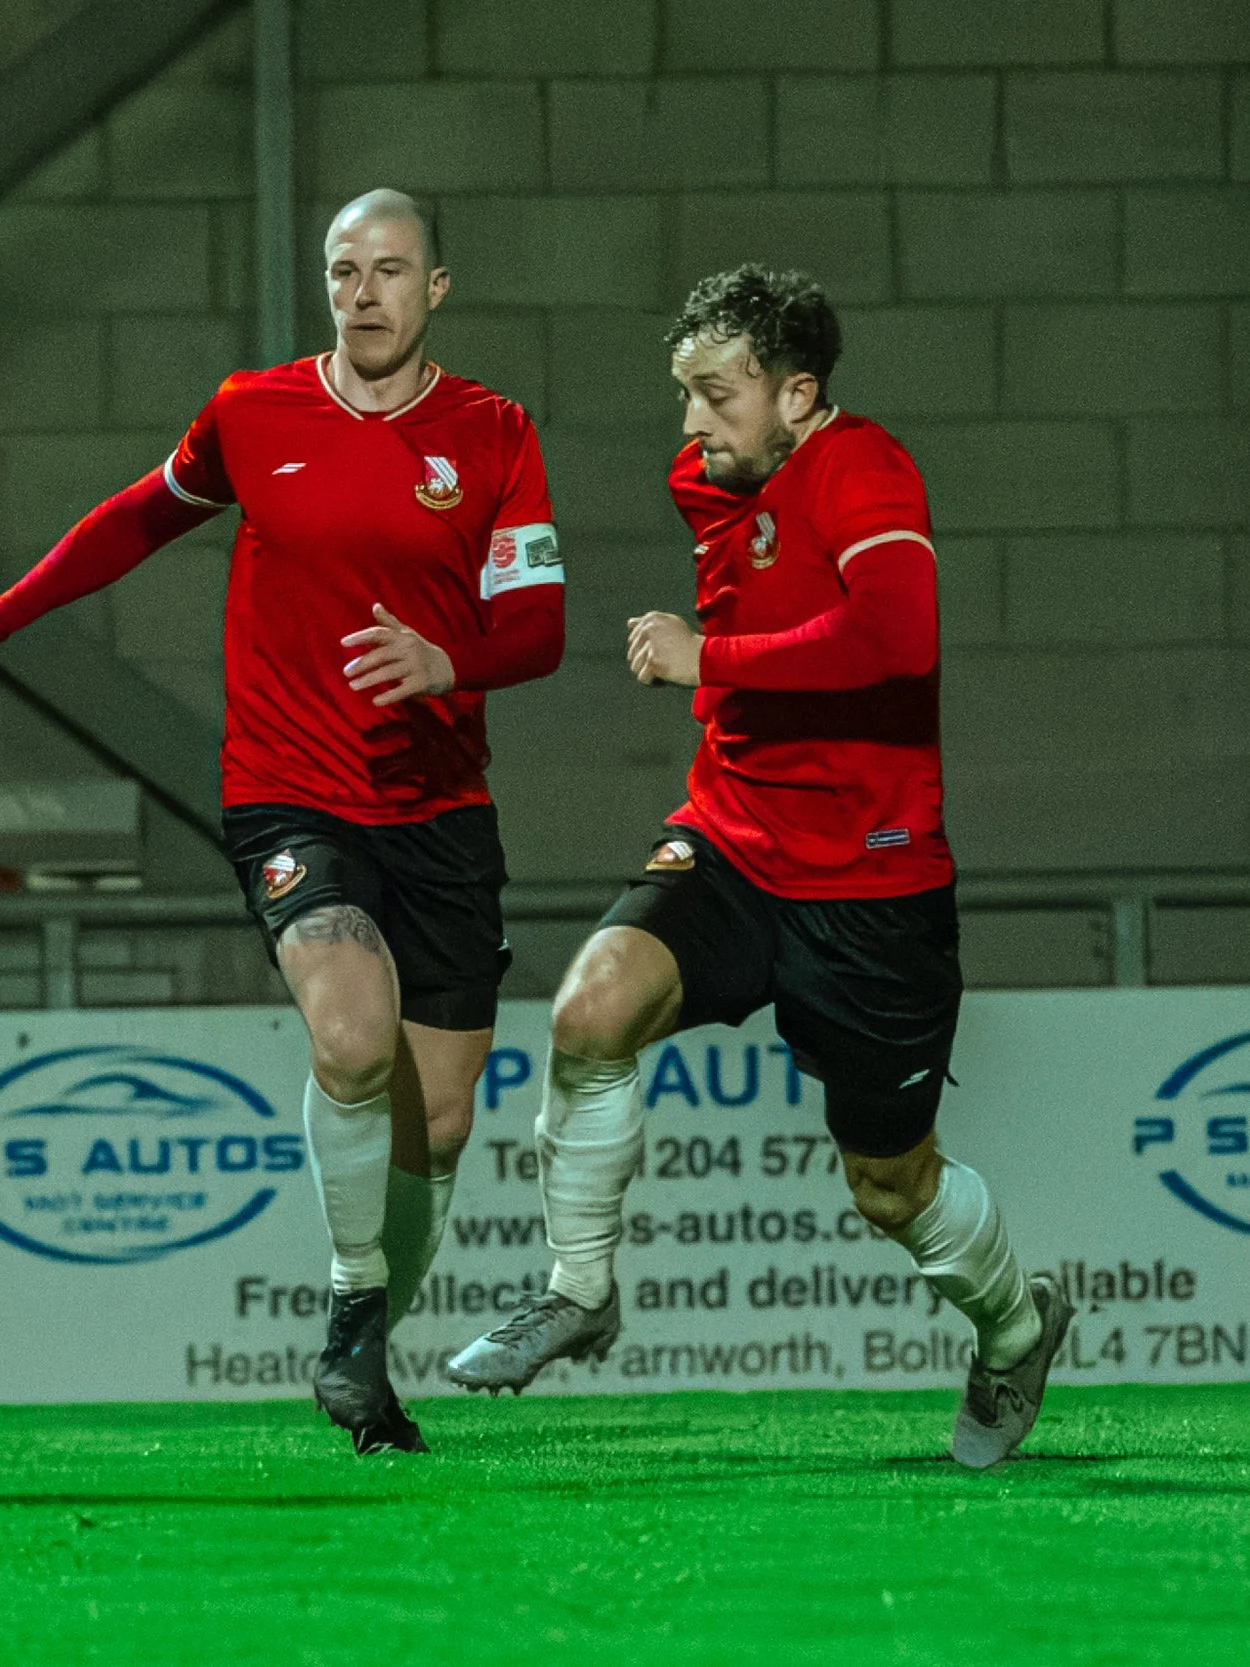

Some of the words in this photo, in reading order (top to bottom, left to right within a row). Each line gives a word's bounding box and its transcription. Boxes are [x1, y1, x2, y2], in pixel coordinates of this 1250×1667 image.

[644, 1042, 805, 1109] AUT
[4, 1138, 48, 1178] S
[81, 1133, 305, 1177] AUTOS
[635, 1264, 729, 1311] and
[588, 1330, 847, 1384] arnworth,
[1052, 1324, 1127, 1369] L4
[1144, 1322, 1248, 1369] 7BN
